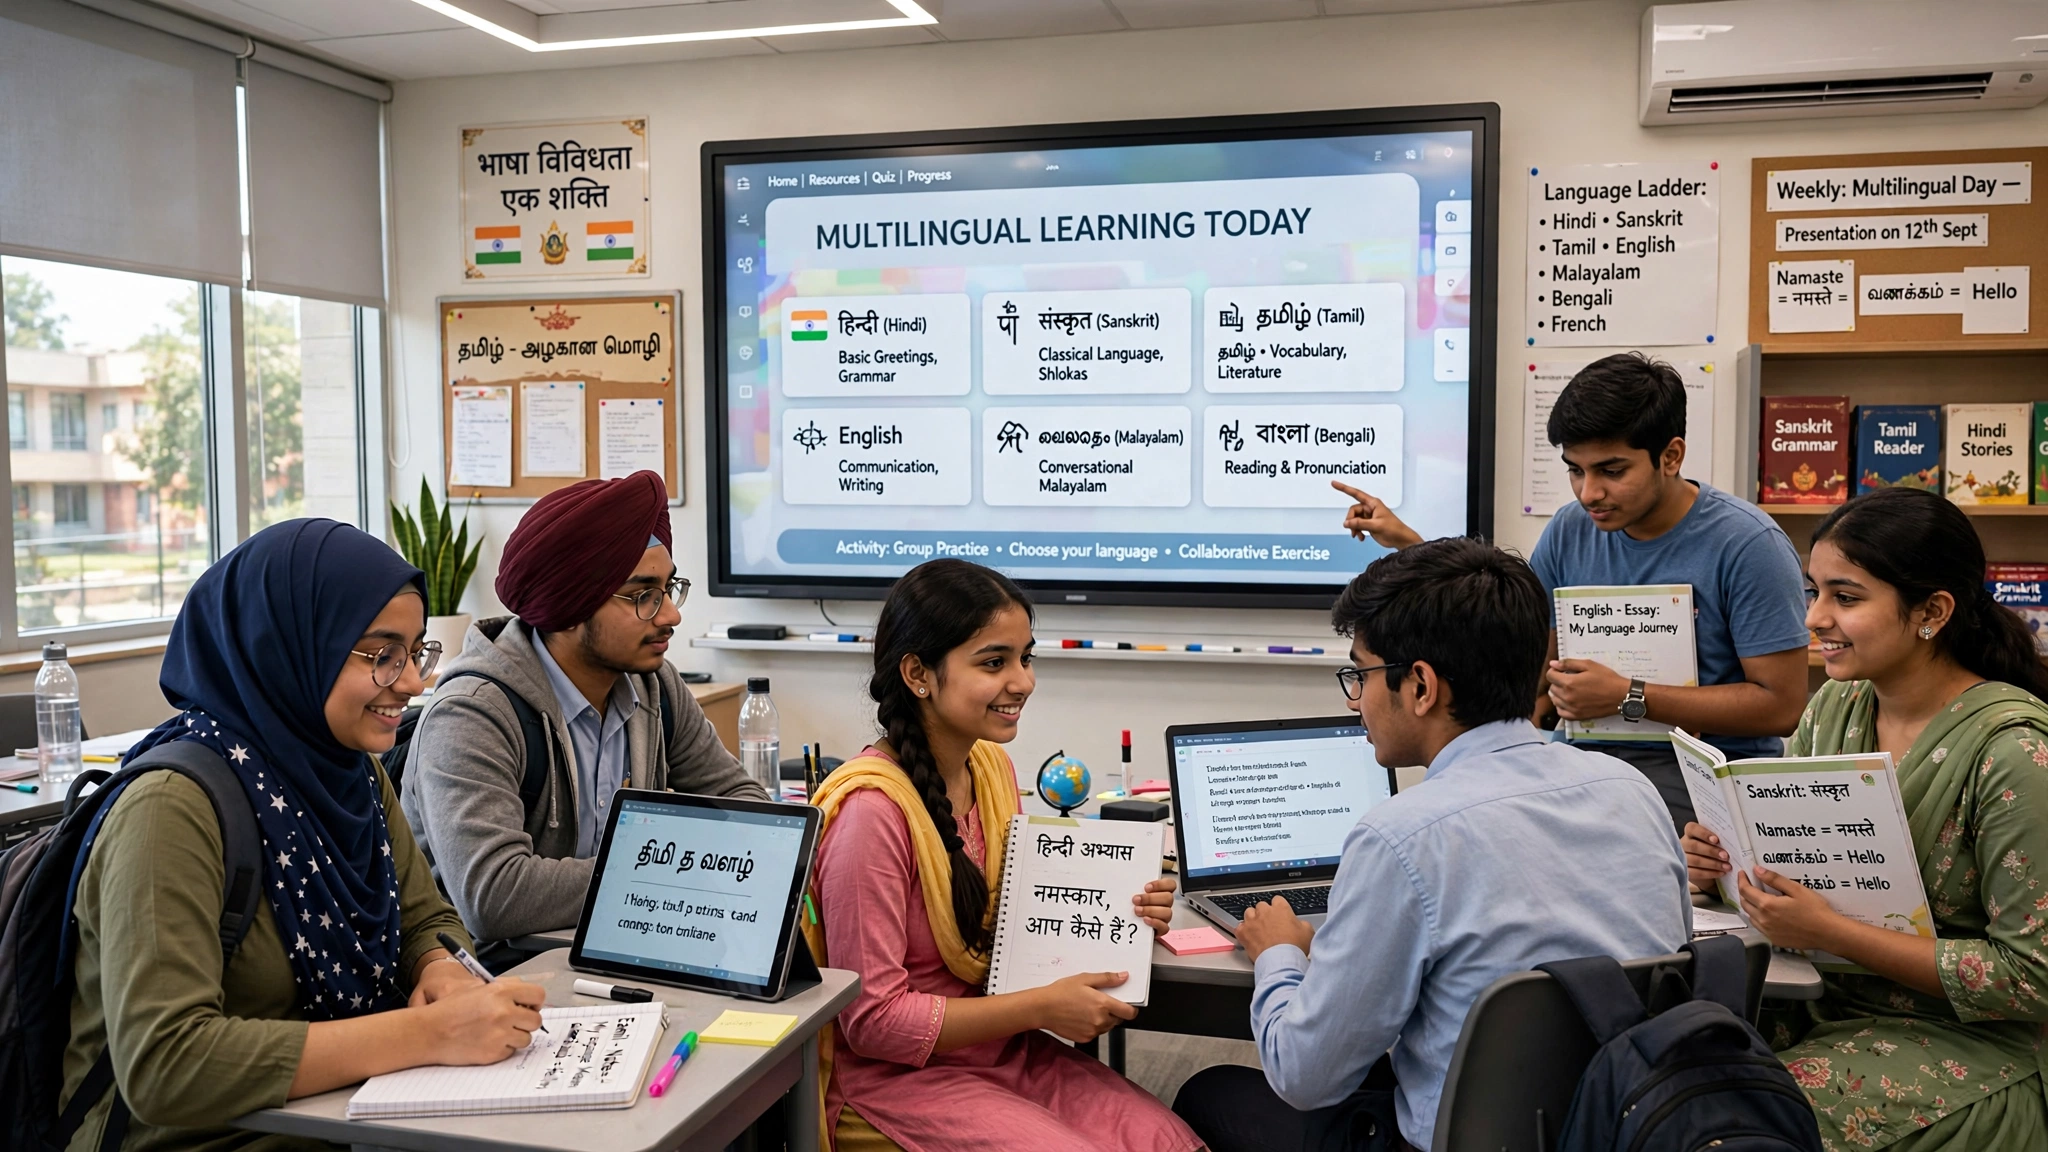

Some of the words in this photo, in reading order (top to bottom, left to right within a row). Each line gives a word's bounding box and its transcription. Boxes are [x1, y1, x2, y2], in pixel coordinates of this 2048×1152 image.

[478, 151, 529, 176] भाषा
[538, 140, 632, 174] विविधता
[768, 175, 798, 188] Home
[809, 172, 860, 187] Resources
[872, 171, 896, 185] Quiz
[907, 169, 952, 184] Progress
[501, 188, 540, 217] एक
[549, 177, 610, 210] शक्ति
[1544, 183, 1632, 204] Language
[1638, 178, 1707, 198] Ladder:
[1777, 179, 1846, 202] Weekly:
[1852, 175, 1956, 200] Multilingual
[1962, 175, 1997, 198] Day
[816, 217, 1031, 250] MULTILINGUAL
[1040, 211, 1196, 243] LEARNING
[1204, 207, 1312, 237] TODAY
[1553, 212, 1596, 230] Hindi
[1616, 209, 1683, 228] Sanskrit
[1785, 223, 1877, 242] Presentation
[1881, 225, 1900, 240] on
[1905, 219, 1938, 240] 12th
[1942, 221, 1978, 241] Sept
[1552, 237, 1595, 256] Tamil
[1616, 235, 1675, 258] English
[1552, 263, 1641, 285] Malayalam
[1777, 270, 1844, 286] Namaste
[1552, 288, 1612, 310] Bengali
[1792, 286, 1832, 306] नमस्ते
[1972, 283, 2018, 300] Hello
[838, 310, 879, 336] हिन्दी
[883, 316, 927, 336] (Hindi)
[1038, 306, 1093, 336] संस्कृत
[1096, 312, 1160, 331] (Sanskrit)
[1256, 302, 1312, 332] தமிழ்
[1317, 307, 1365, 327] (Tamil)
[1552, 314, 1606, 332] French
[458, 336, 504, 363] தமிழ்
[521, 339, 597, 363] அழகான
[604, 332, 662, 361] மொழி
[1038, 346, 1093, 362] Classical
[1097, 346, 1164, 364] Language,
[1218, 342, 1257, 363] தமிழ்
[1270, 343, 1347, 361] Vocabulary,
[838, 350, 872, 364] Basic
[874, 349, 938, 366] Greetings,
[838, 369, 896, 384] Grammar
[1038, 366, 1088, 382] Shlokas
[1218, 364, 1281, 379] Literature
[1255, 422, 1310, 445] বাংলা
[1314, 427, 1376, 447] (Bengali)
[1775, 418, 1832, 434] Sanskrit
[1878, 422, 1917, 437] Tamil
[1967, 423, 2006, 438] Hindi
[839, 425, 902, 450] English
[1114, 429, 1184, 447] (Malayalam)
[1771, 437, 1838, 452] Grammar
[1874, 440, 1925, 455] Reader
[1961, 442, 2013, 457] Stories
[839, 459, 939, 475] Communication,
[1039, 459, 1133, 475] Conversational
[1225, 459, 1277, 478] Reading
[1281, 461, 1291, 475] &
[1295, 460, 1386, 476] Pronunciation
[839, 477, 884, 495] Writing
[1039, 478, 1107, 495] Malayalam
[836, 540, 890, 557] Activity:
[893, 541, 933, 558] Group
[936, 541, 989, 556] Practice
[1009, 542, 1059, 557] Choose
[1061, 546, 1092, 560] your
[1096, 543, 1158, 561] language
[1178, 544, 1269, 560] Collaborative
[1272, 545, 1331, 561] Exercise
[1573, 603, 1613, 620] English
[1624, 603, 1660, 619] Essay:
[1569, 623, 1584, 637] My
[1587, 622, 1635, 637] Language
[1638, 622, 1678, 637] Journey
[1747, 783, 1806, 799] Sanskrit:
[1808, 780, 1850, 802] संस्कृत
[1755, 822, 1816, 837] Namaste
[1835, 818, 1876, 837] नमस्ते
[1037, 833, 1075, 858] हिन्दी
[1080, 842, 1135, 861] अभ्यास
[1847, 849, 1885, 864] Hello
[1855, 876, 1891, 890] Hello
[1034, 885, 1111, 911] नमस्कार,
[1025, 916, 1063, 936] आप
[1070, 913, 1104, 940] कैसे
